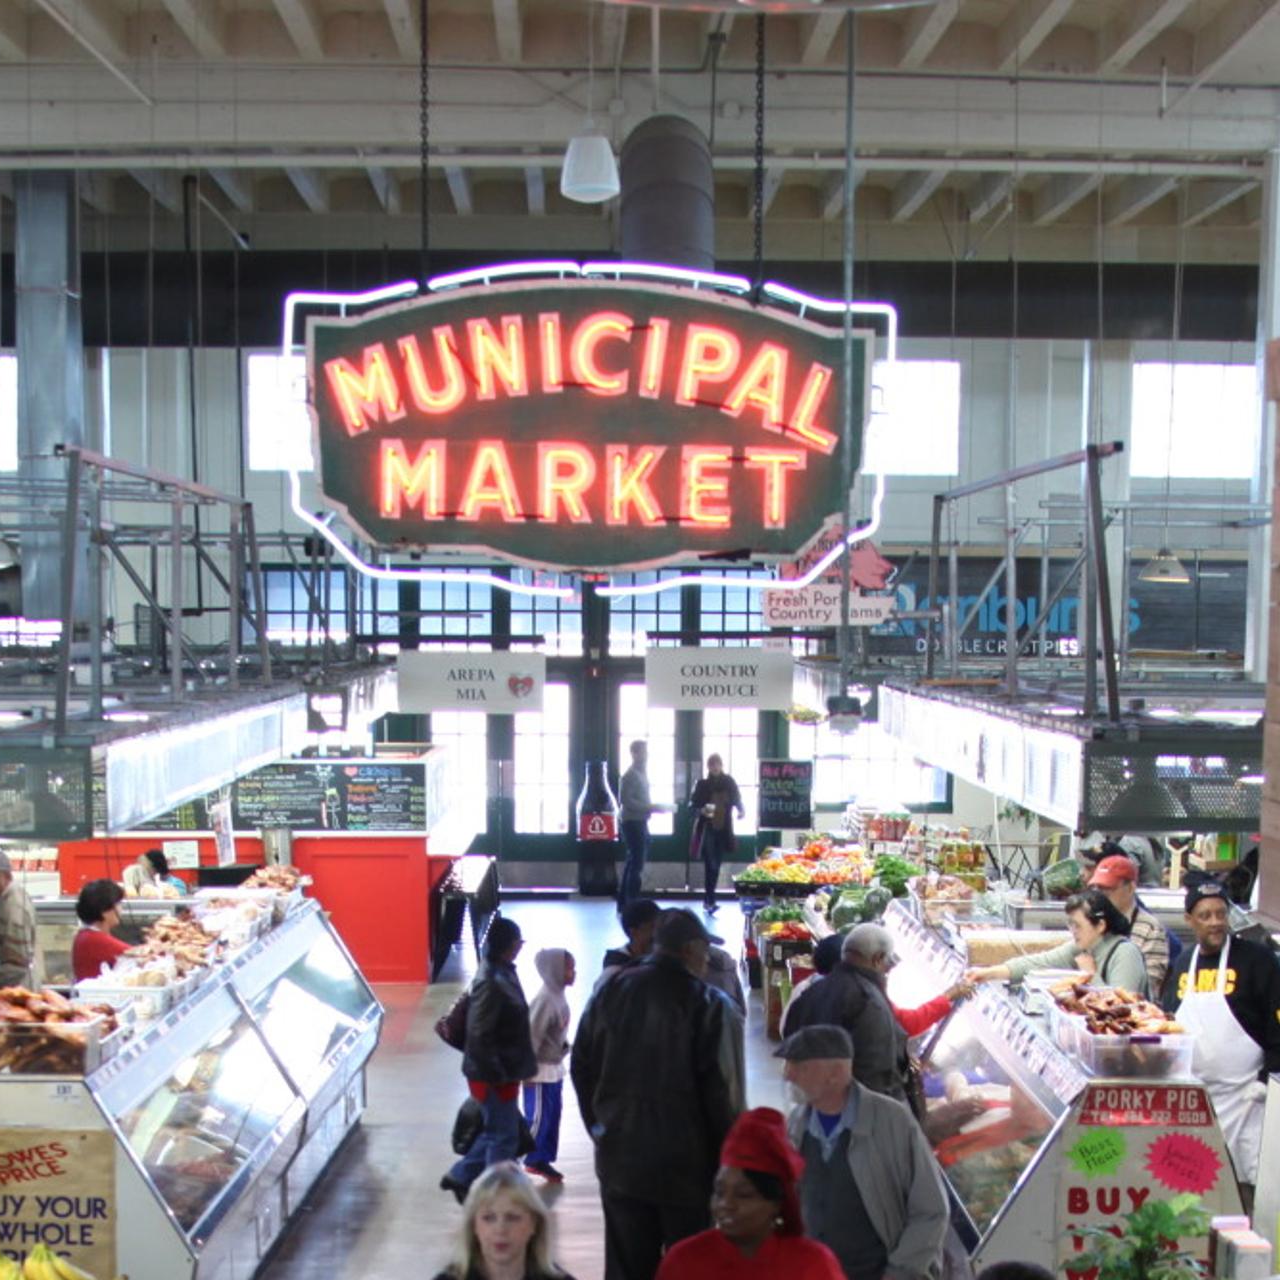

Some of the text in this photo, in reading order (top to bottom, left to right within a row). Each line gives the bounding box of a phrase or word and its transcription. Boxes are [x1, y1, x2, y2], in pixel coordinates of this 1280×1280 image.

[324, 311, 839, 455] MUNICIPAL
[379, 437, 807, 529] MARKET
[768, 591, 844, 606] Fresh Por
[770, 608, 882, 621] Country ams
[986, 638, 1036, 652] CRST
[447, 669, 495, 681] AREPA
[680, 664, 759, 678] COUNTRY
[456, 688, 487, 700] MIA
[681, 684, 759, 697] PRODUCE
[1167, 1089, 1199, 1109] PIG
[35, 1197, 107, 1219] YOUR
[1068, 1187, 1150, 1215] BUY
